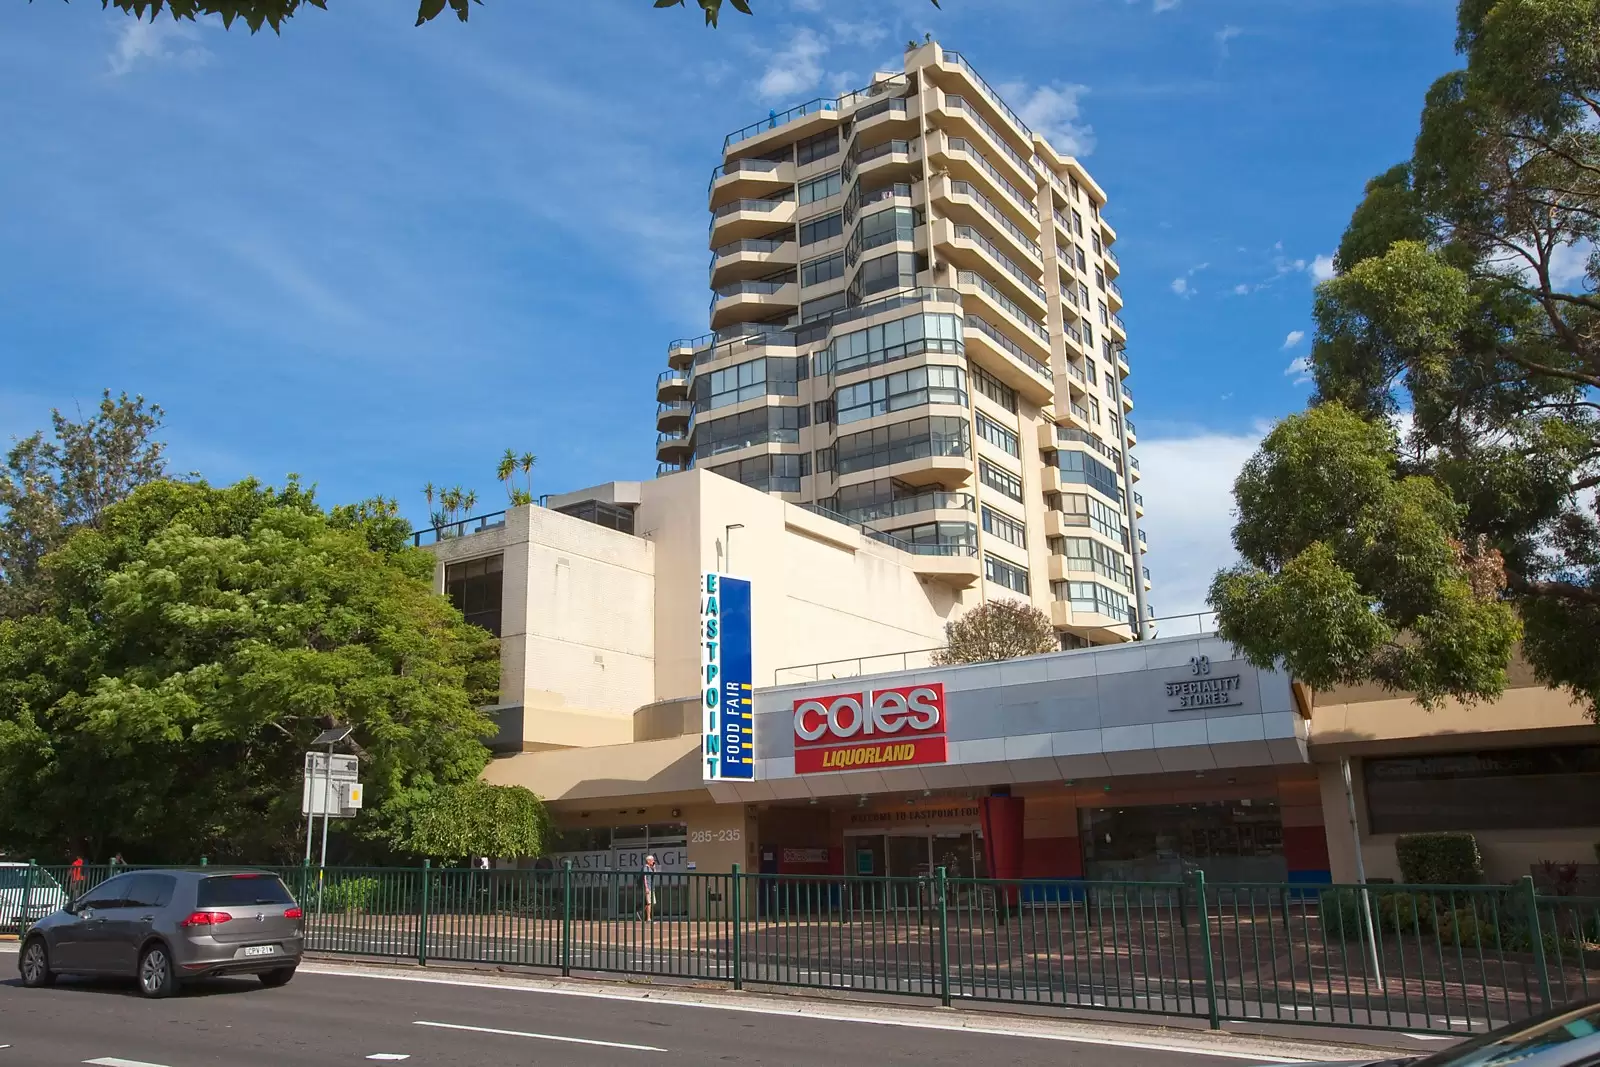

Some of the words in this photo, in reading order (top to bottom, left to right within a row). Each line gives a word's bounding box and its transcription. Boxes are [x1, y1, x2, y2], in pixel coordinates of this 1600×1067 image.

[705, 573, 719, 779] EASTPOINT
[1189, 655, 1211, 675] 33
[1165, 678, 1240, 696] SPECIALITY
[727, 681, 740, 716] FAIR
[1180, 692, 1229, 706] STORES
[793, 688, 940, 741] coles
[727, 724, 740, 764] FOOD
[822, 743, 915, 768] LIQUORLAND
[961, 807, 979, 817] FOO
[691, 829, 740, 843] 285-235
